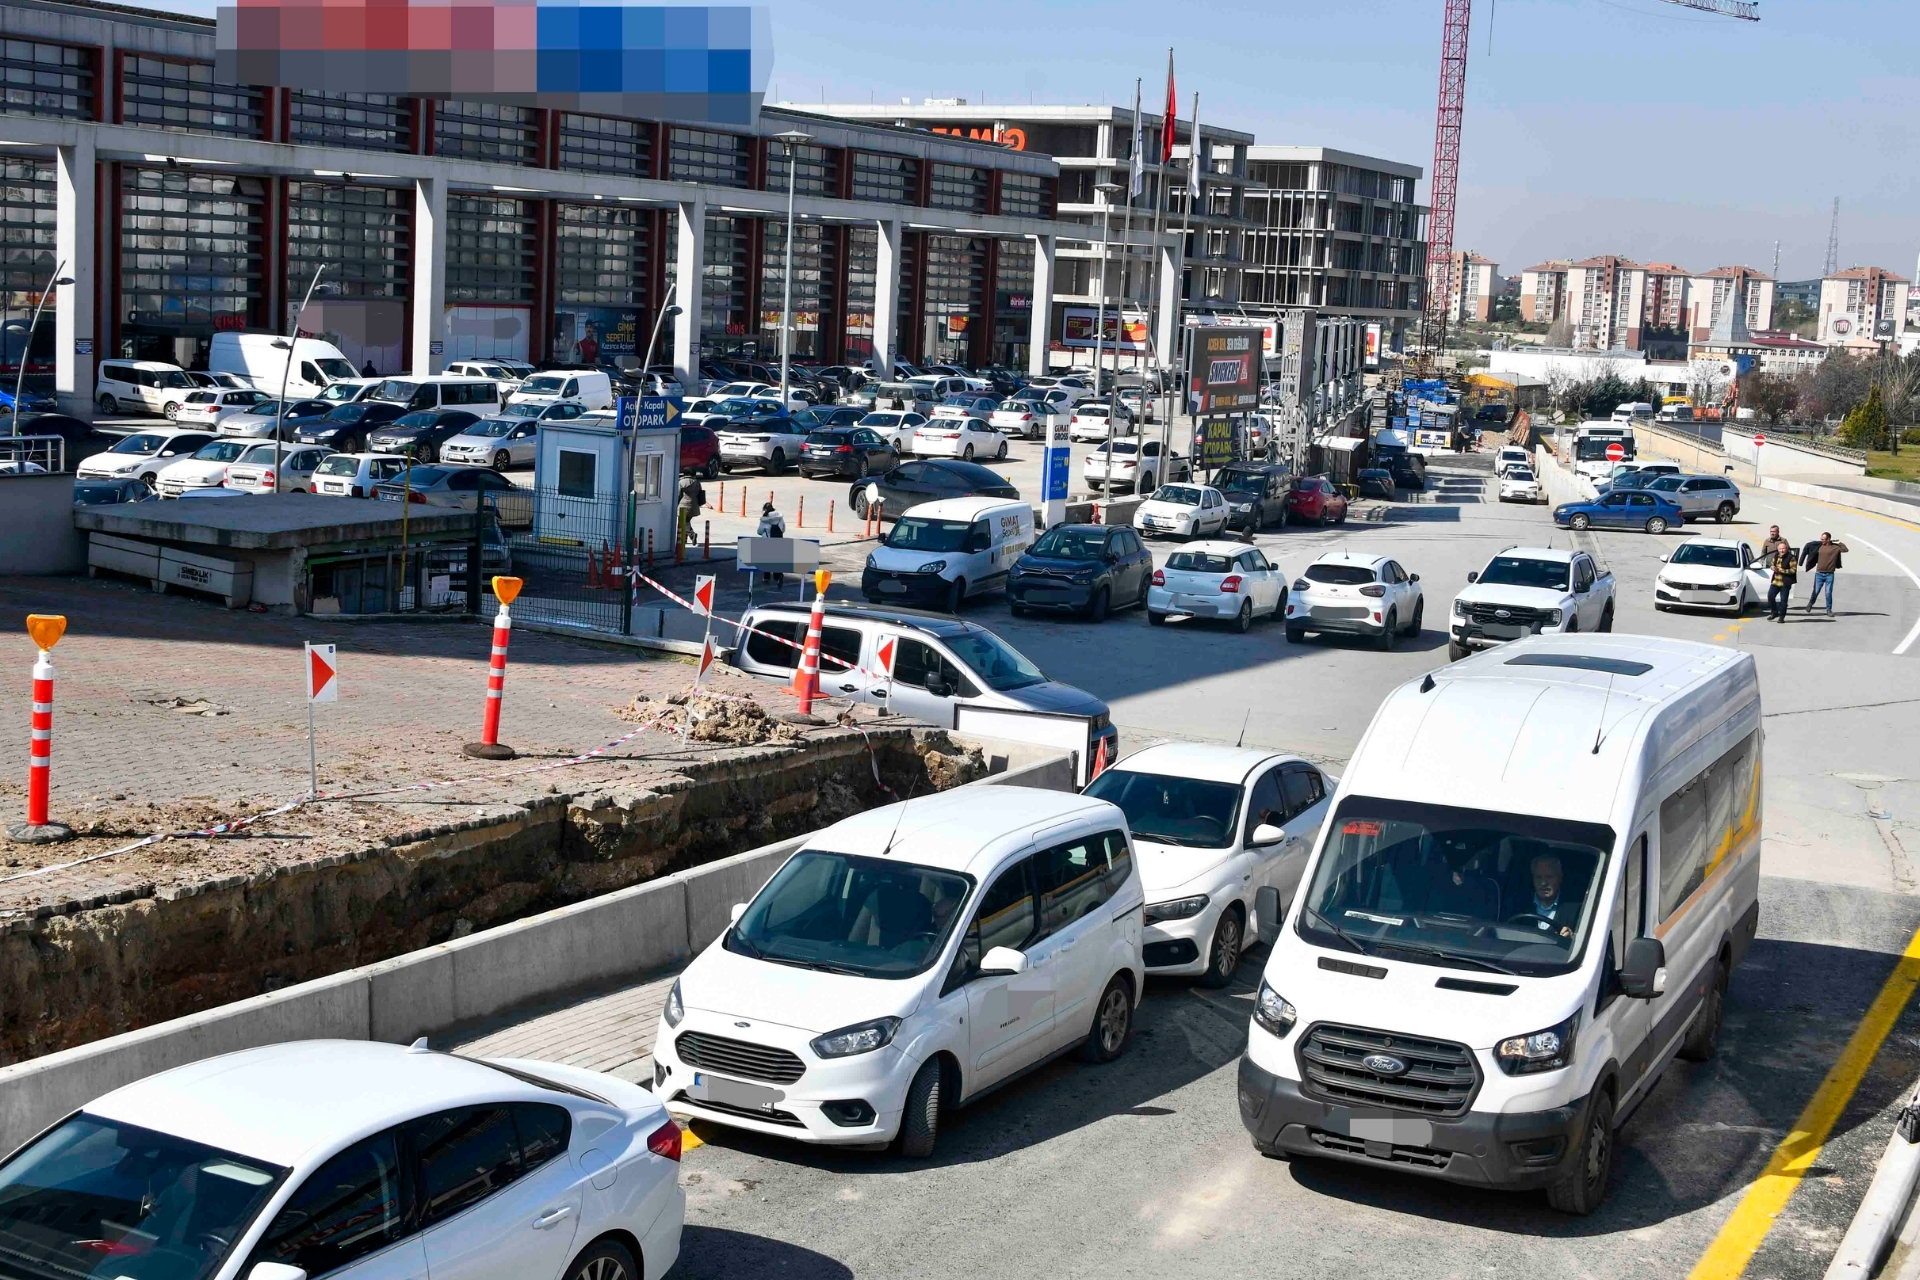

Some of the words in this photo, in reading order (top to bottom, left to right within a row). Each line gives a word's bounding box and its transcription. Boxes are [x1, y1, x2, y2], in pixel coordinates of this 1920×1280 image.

[1874, 334, 1893, 342] Jeep
[1209, 361, 1240, 383] SNICKERS
[644, 399, 665, 412] Kapalı
[1208, 422, 1232, 438] KAPALI
[1054, 433, 1069, 441] GROSS
[1204, 440, 1233, 455] OTOPARK
[1371, 1058, 1394, 1070] Ford
